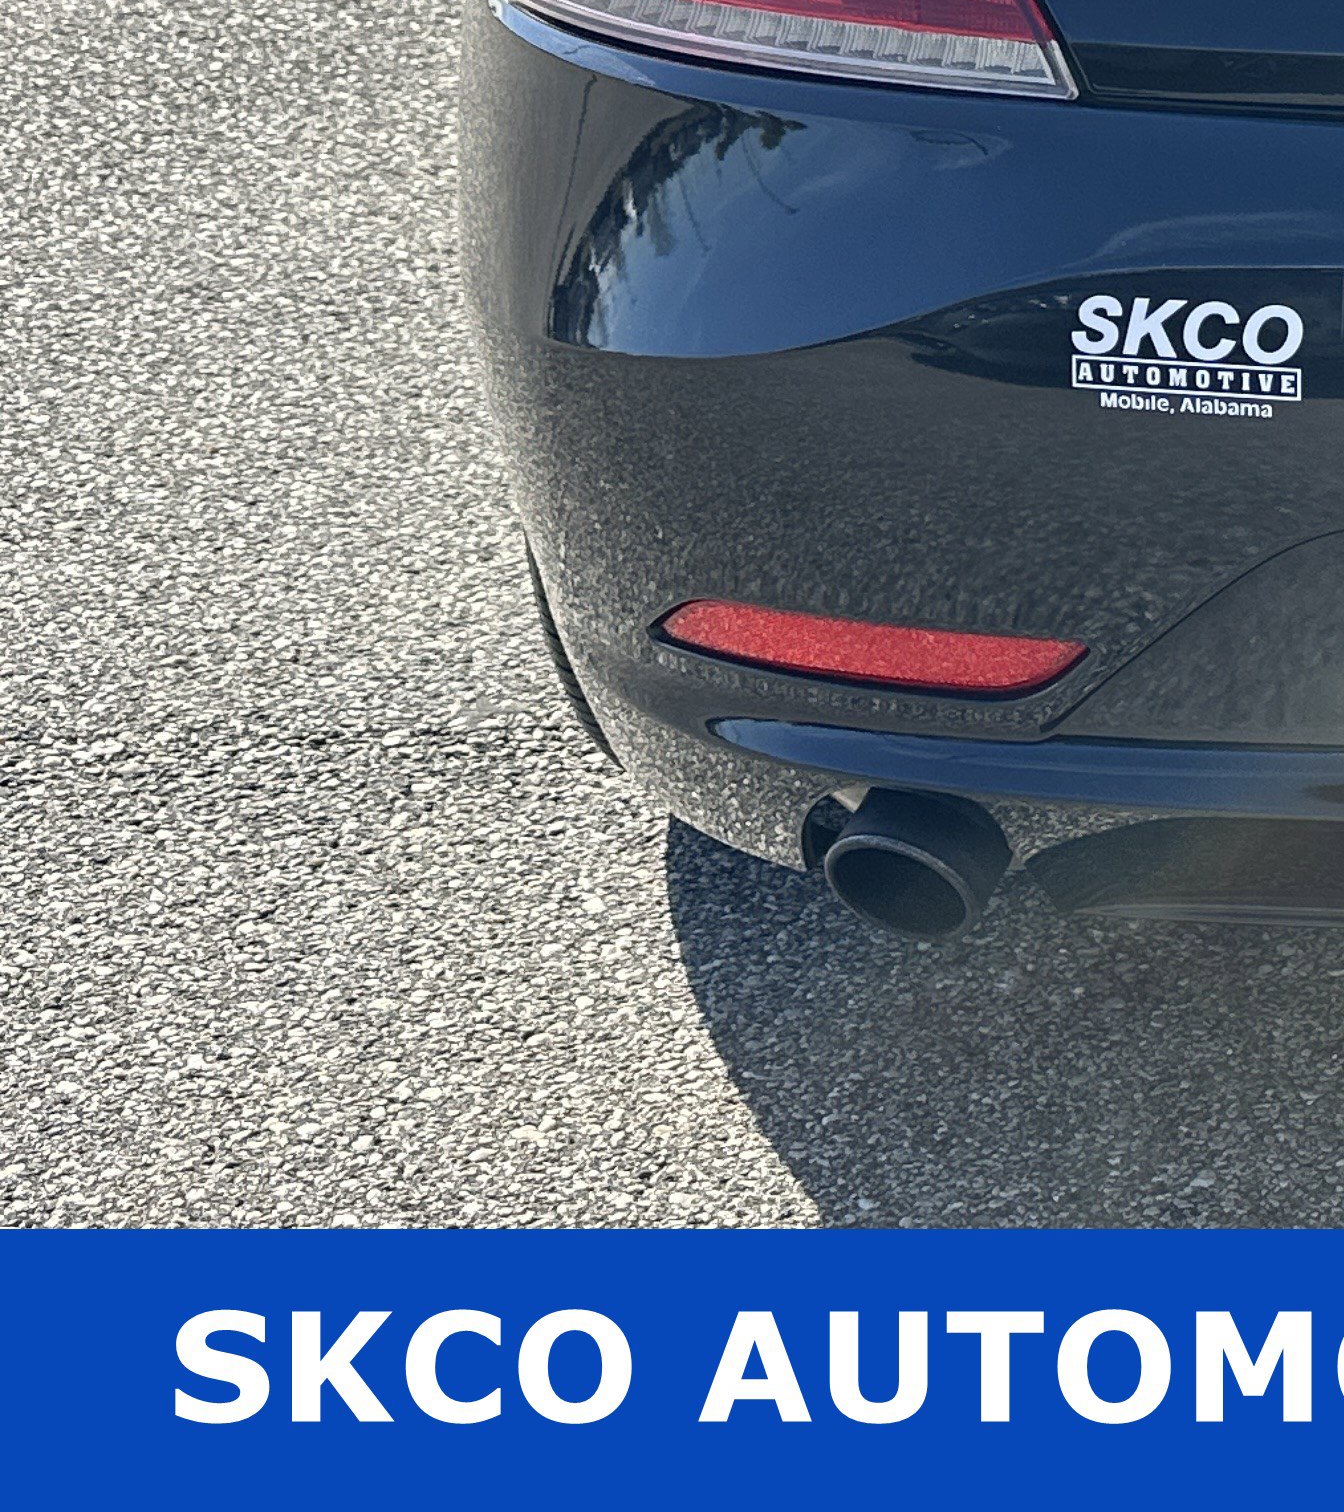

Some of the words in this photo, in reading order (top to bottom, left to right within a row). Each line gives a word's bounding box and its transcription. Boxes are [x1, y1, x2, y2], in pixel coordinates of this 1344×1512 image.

[1071, 294, 1304, 365] SKCO
[1077, 362, 1297, 394] AUTOMOTIVE
[1100, 392, 1175, 414] Mobile,
[1180, 397, 1273, 418] Alabama
